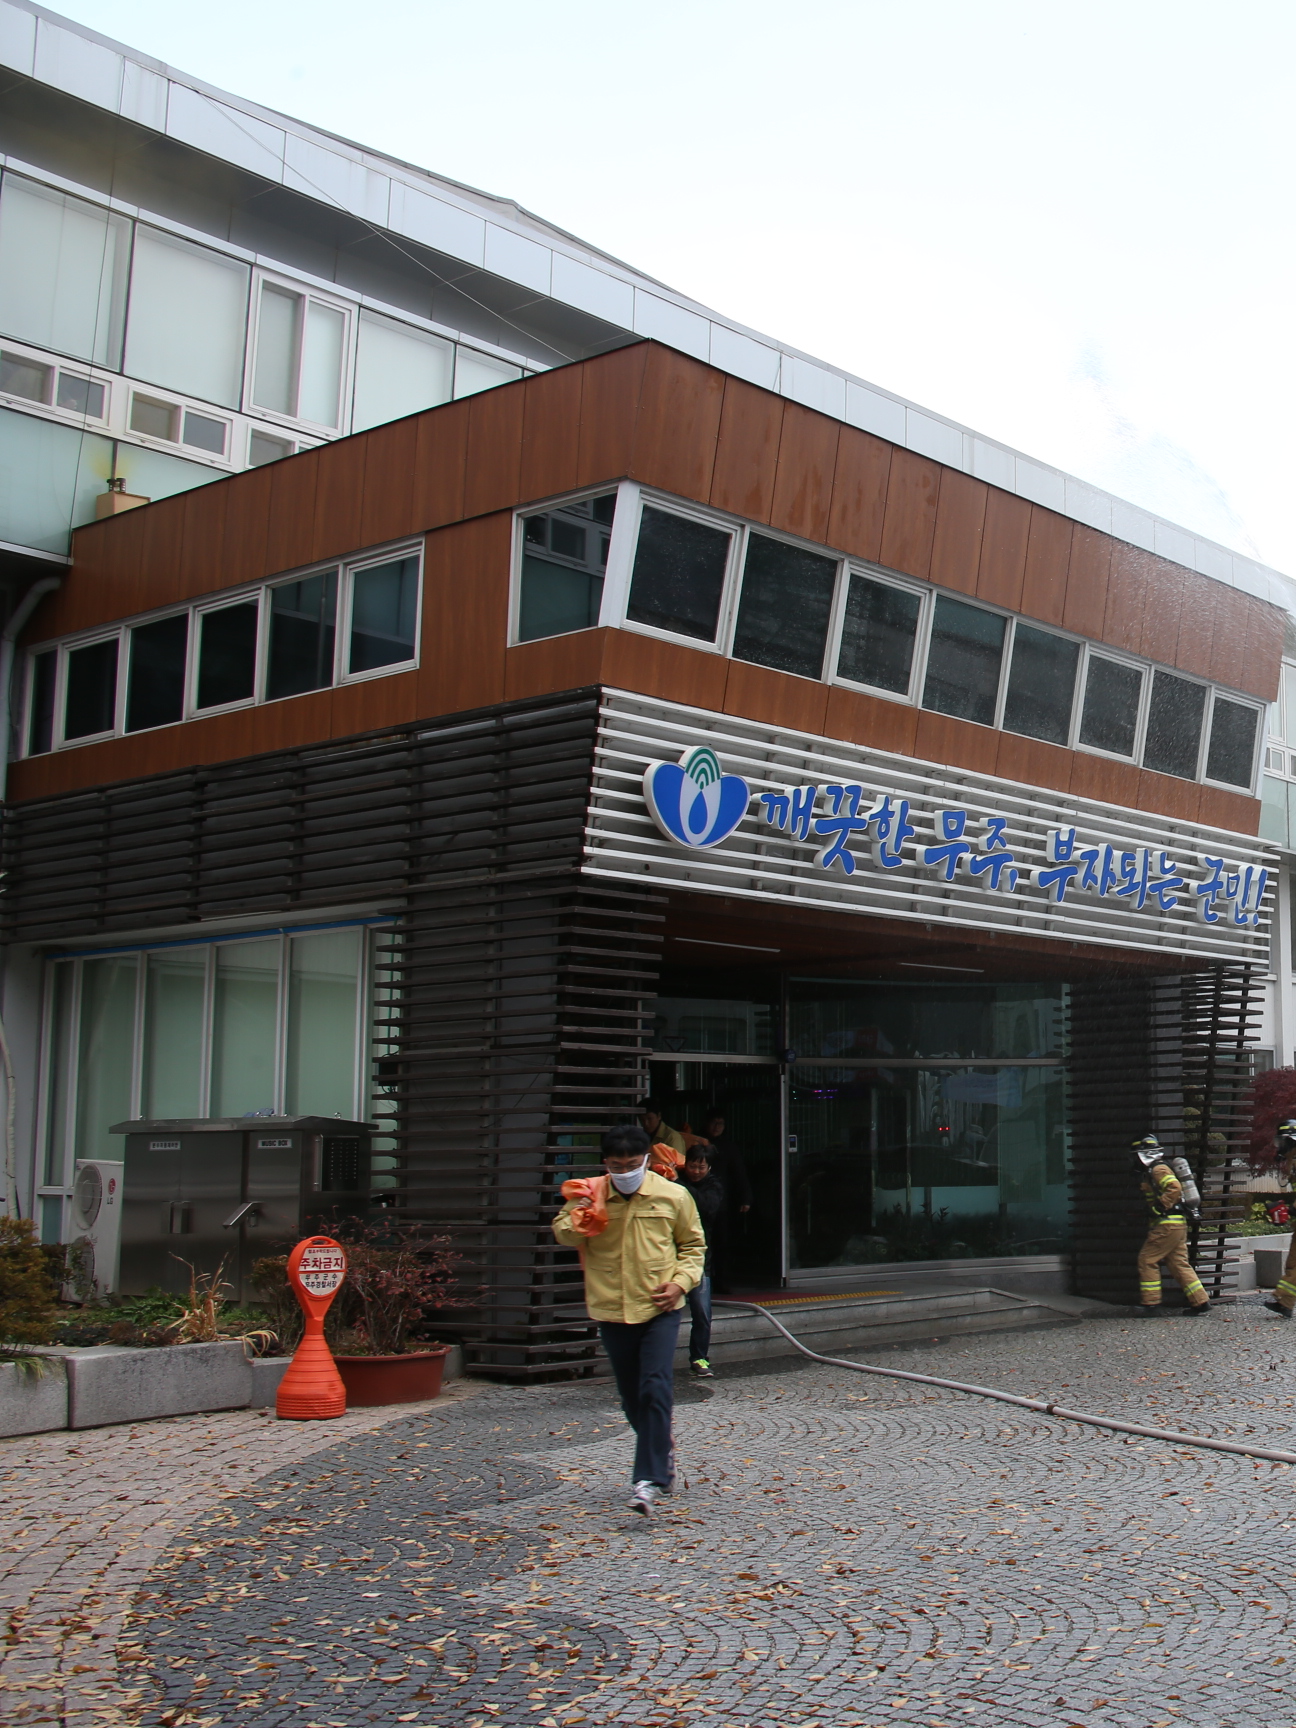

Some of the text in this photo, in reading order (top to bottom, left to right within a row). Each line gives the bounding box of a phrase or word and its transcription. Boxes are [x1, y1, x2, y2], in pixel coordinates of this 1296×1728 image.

[751, 784, 1267, 926] 깨끗한 무주, 부자되는 군민!
[278, 1139, 289, 1147] BOX
[106, 1196, 114, 1205] LG
[300, 1257, 343, 1269] 주차금지
